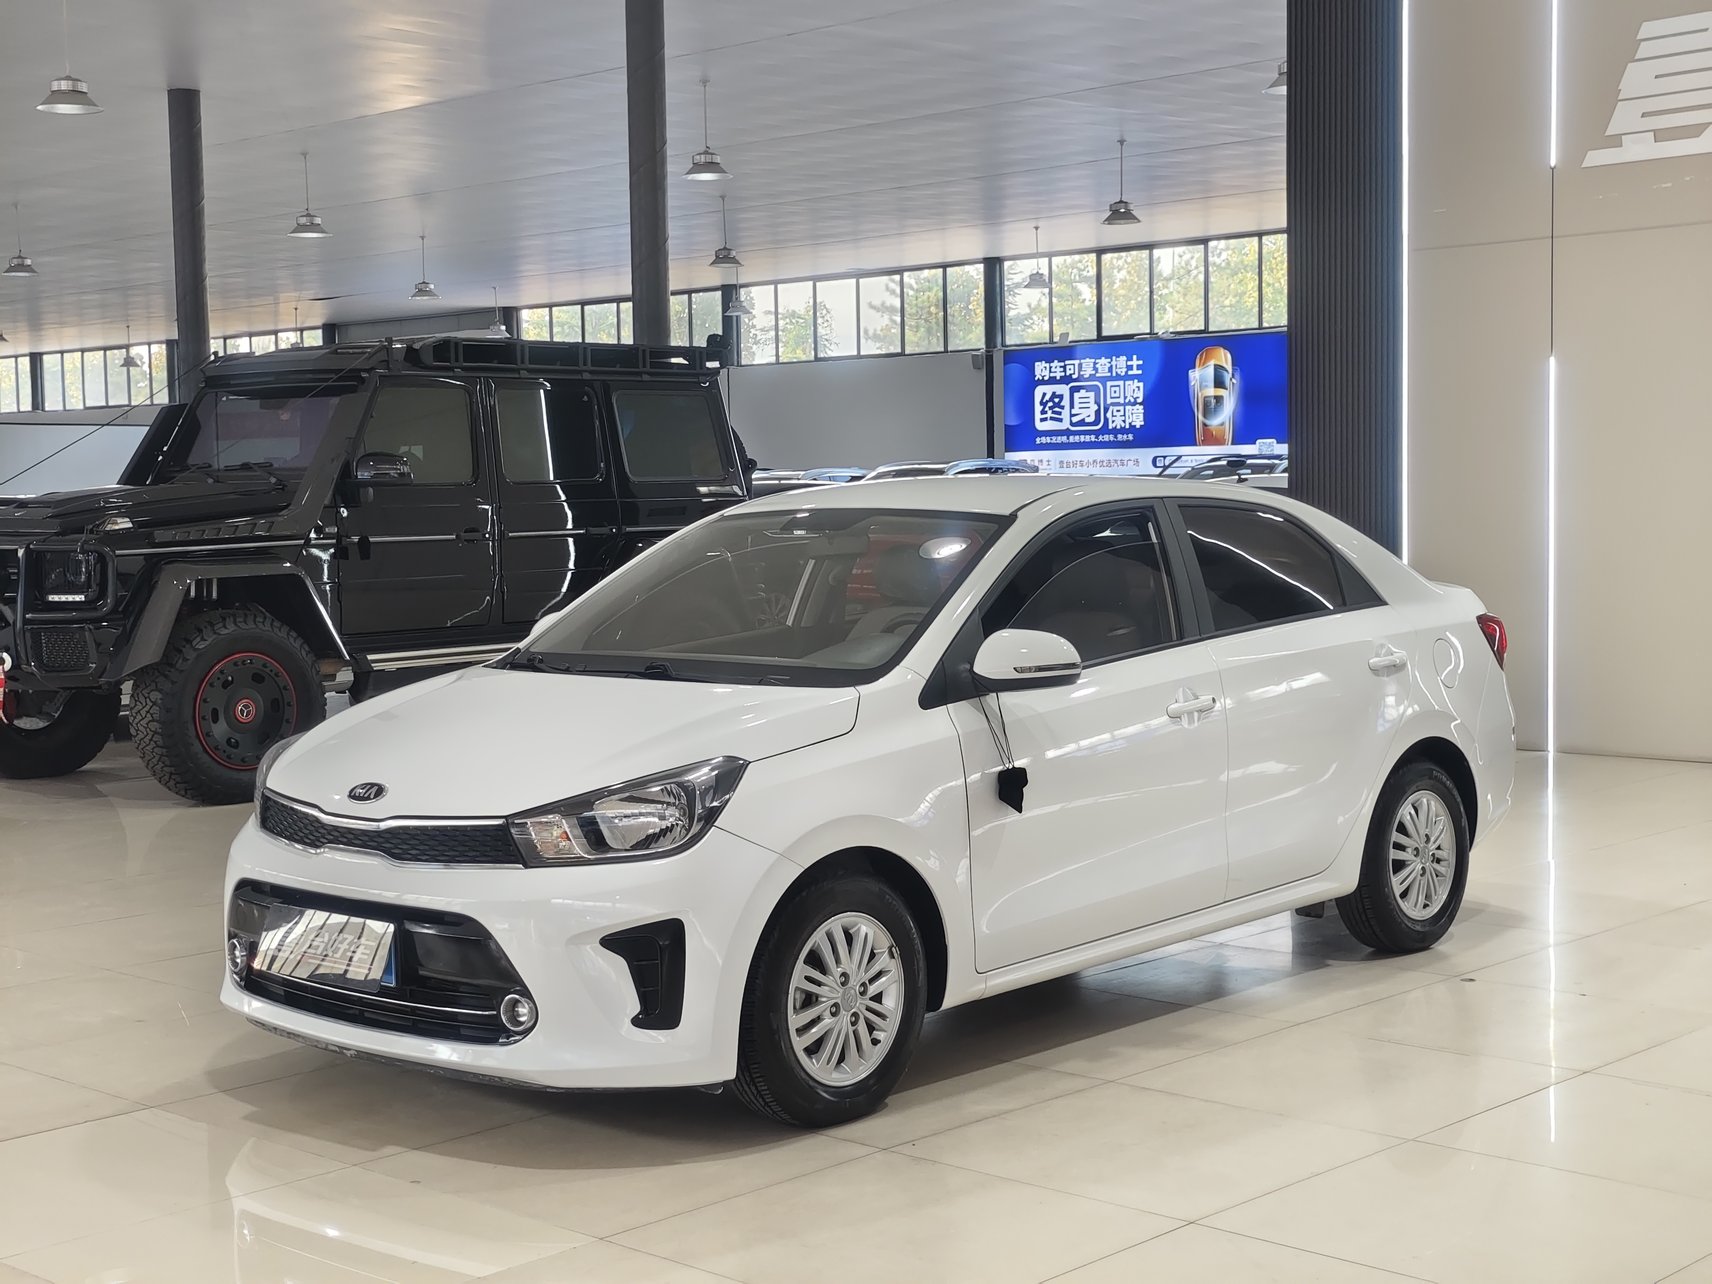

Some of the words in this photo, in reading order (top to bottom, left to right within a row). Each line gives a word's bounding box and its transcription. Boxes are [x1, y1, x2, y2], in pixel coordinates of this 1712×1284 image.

[1034, 355, 1144, 380] 购车可享查博士
[1105, 379, 1144, 404] 回购
[1038, 389, 1099, 424] 终身
[1105, 404, 1145, 429] 保障
[349, 783, 381, 800] KIA
